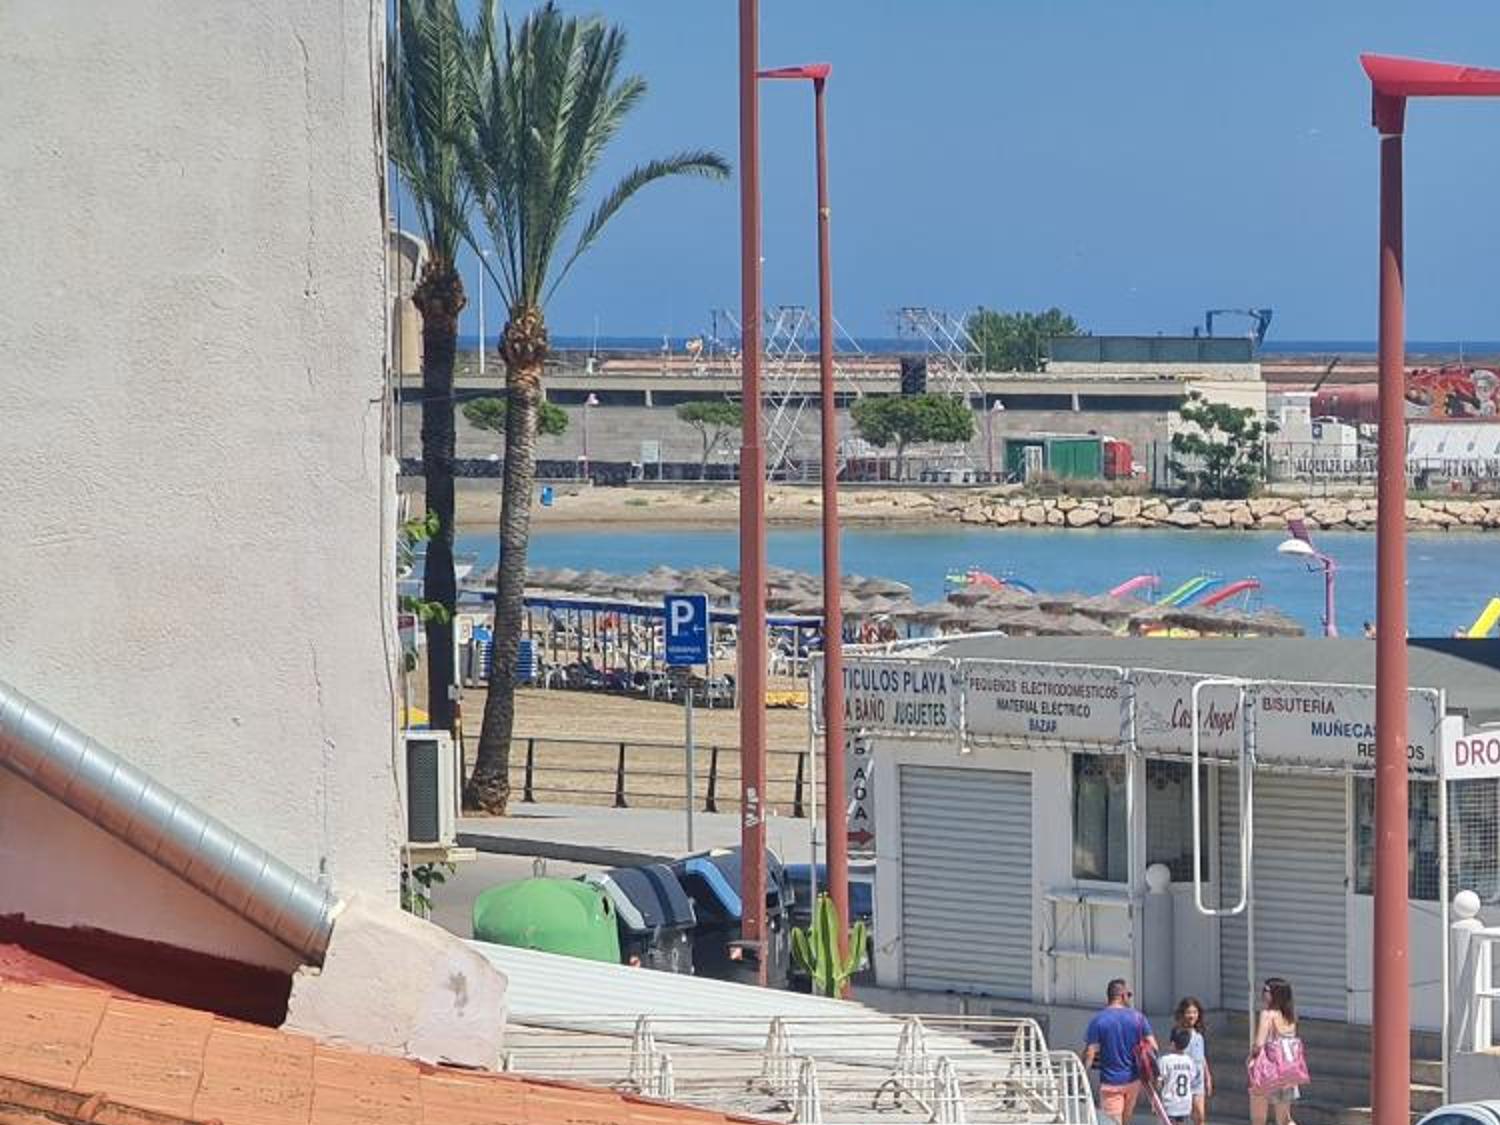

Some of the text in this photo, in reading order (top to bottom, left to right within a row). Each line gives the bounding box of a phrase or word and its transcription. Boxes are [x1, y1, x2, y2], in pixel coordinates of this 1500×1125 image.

[671, 599, 695, 636] P
[824, 667, 948, 695] TICULOS PLAYA
[855, 693, 885, 723] BAÑO
[893, 701, 948, 726] JUGUETES
[996, 697, 1038, 715] MATERIAL
[1262, 696, 1335, 715] BISUTERÍA
[1028, 717, 1057, 733] BAZAR
[1176, 1073, 1188, 1097] 8
